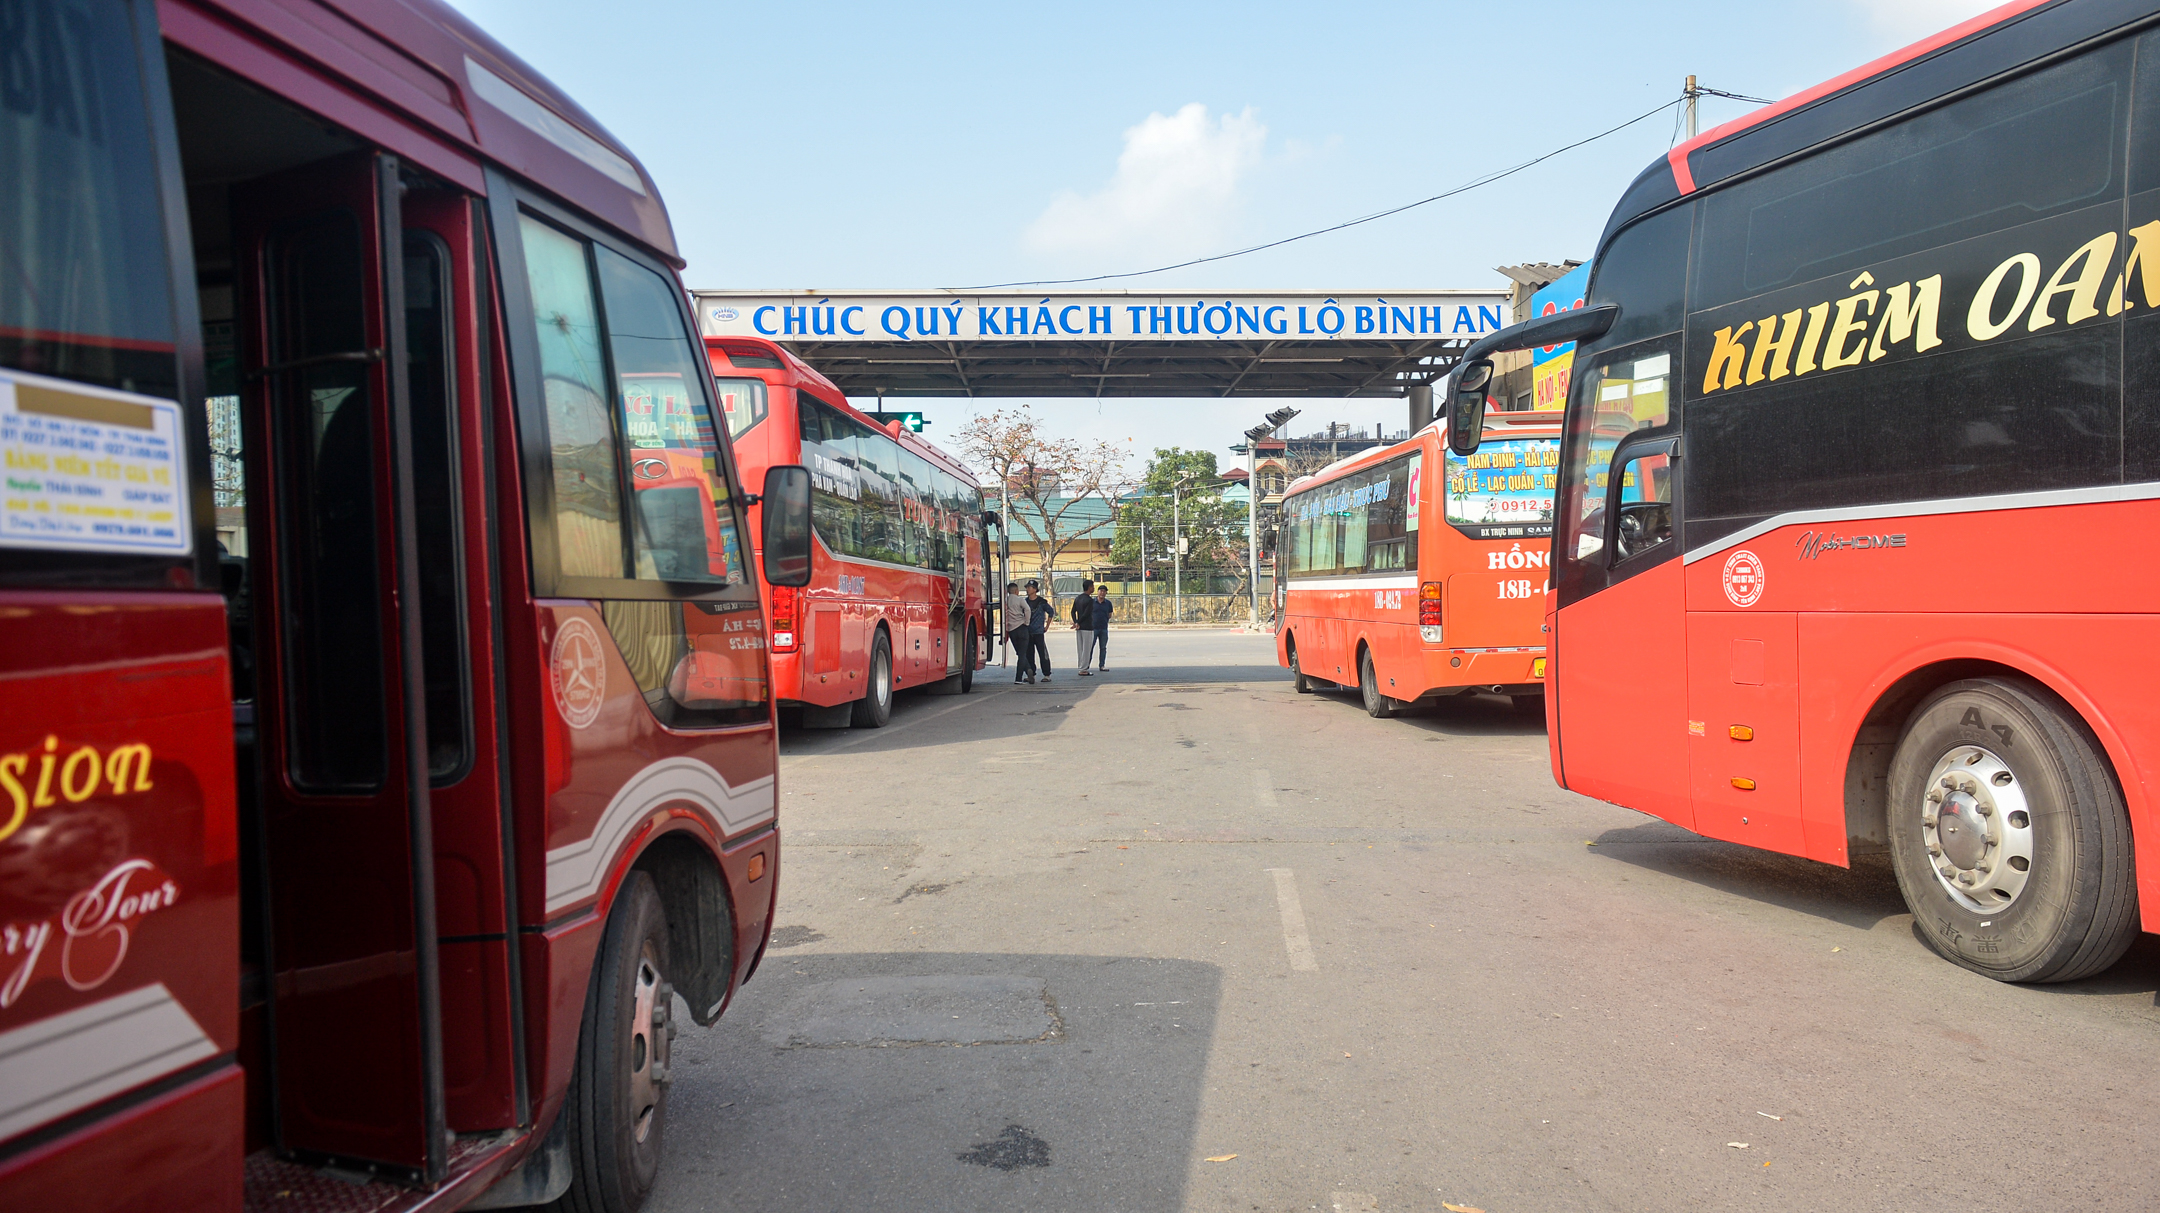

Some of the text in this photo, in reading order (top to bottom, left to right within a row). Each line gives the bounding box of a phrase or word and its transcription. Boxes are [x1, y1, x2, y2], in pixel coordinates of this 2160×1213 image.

[752, 297, 866, 336] CHÚC
[880, 298, 964, 341] QUÝ
[978, 297, 1111, 336] KHÁCH
[1126, 301, 1288, 340] THƯỢNG
[1298, 298, 1346, 340] LỘ
[1354, 297, 1443, 336] BÌNH
[1452, 304, 1502, 334] AN
[1702, 270, 1943, 395] KHIÊM
[1537, 372, 1545, 407] HÀ
[1545, 370, 1555, 408] NỘI
[814, 453, 822, 470] TP
[822, 457, 842, 477] THANH
[1467, 454, 1490, 470] NAM
[1492, 452, 1517, 471] ĐỊNH
[1524, 447, 1541, 468] HẢI
[1451, 471, 1466, 493] CỔ
[1466, 471, 1479, 493] LỄ
[1487, 476, 1506, 494] LẠC
[903, 494, 935, 530] TÙNG
[1300, 500, 1309, 521] HÀ
[1310, 497, 1321, 523] NỘI
[1335, 488, 1351, 515] HẬU
[1353, 482, 1373, 512] TRỰC
[1481, 528, 1490, 537] BX
[1490, 527, 1507, 538] TRỰC
[1507, 527, 1524, 537] NINH
[62, 858, 177, 992] Tour
